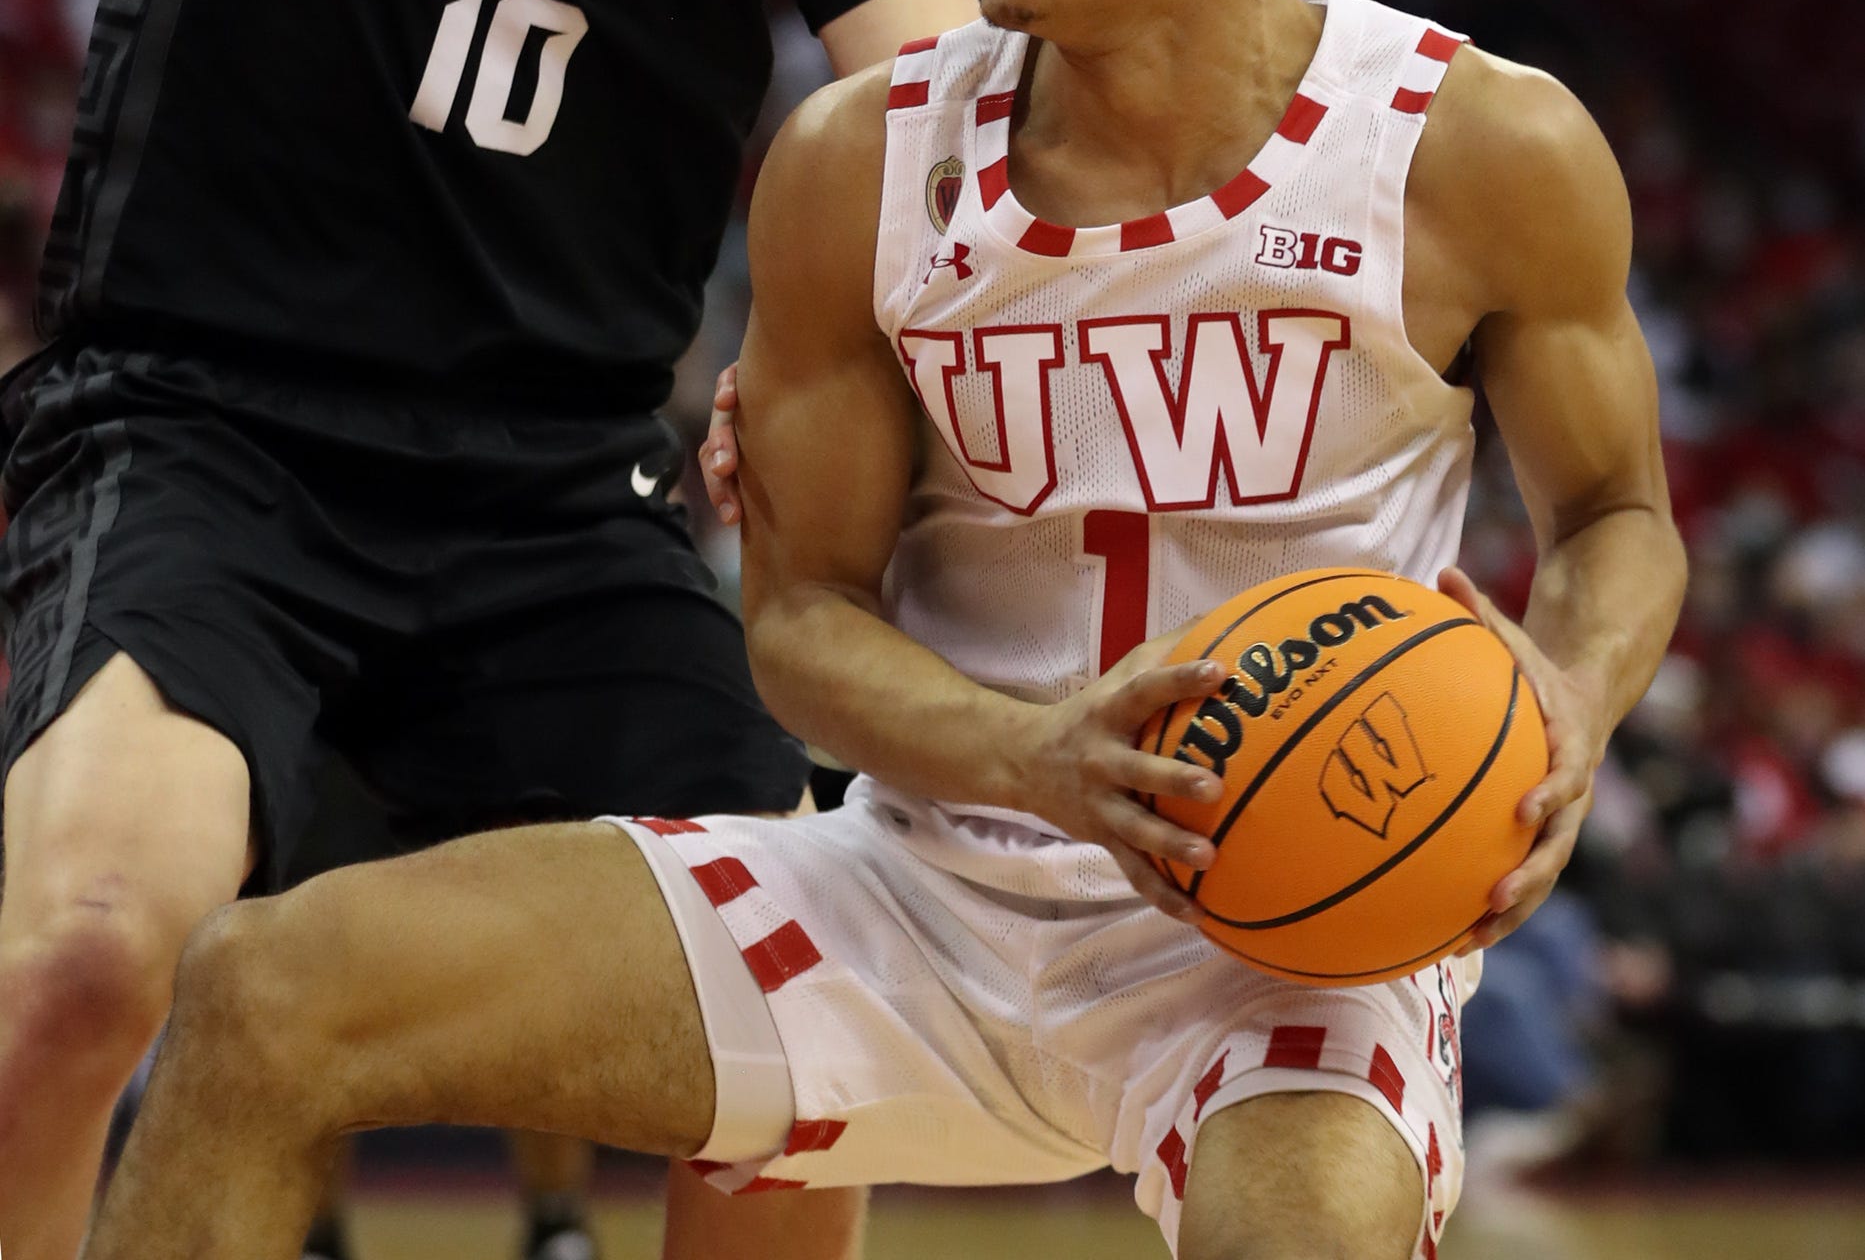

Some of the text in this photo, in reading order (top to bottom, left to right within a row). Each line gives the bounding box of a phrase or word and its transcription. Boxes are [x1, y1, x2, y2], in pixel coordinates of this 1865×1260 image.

[900, 308, 1351, 517] UW
[1083, 509, 1149, 678] 1
[1269, 657, 1339, 721] EVO NXT
